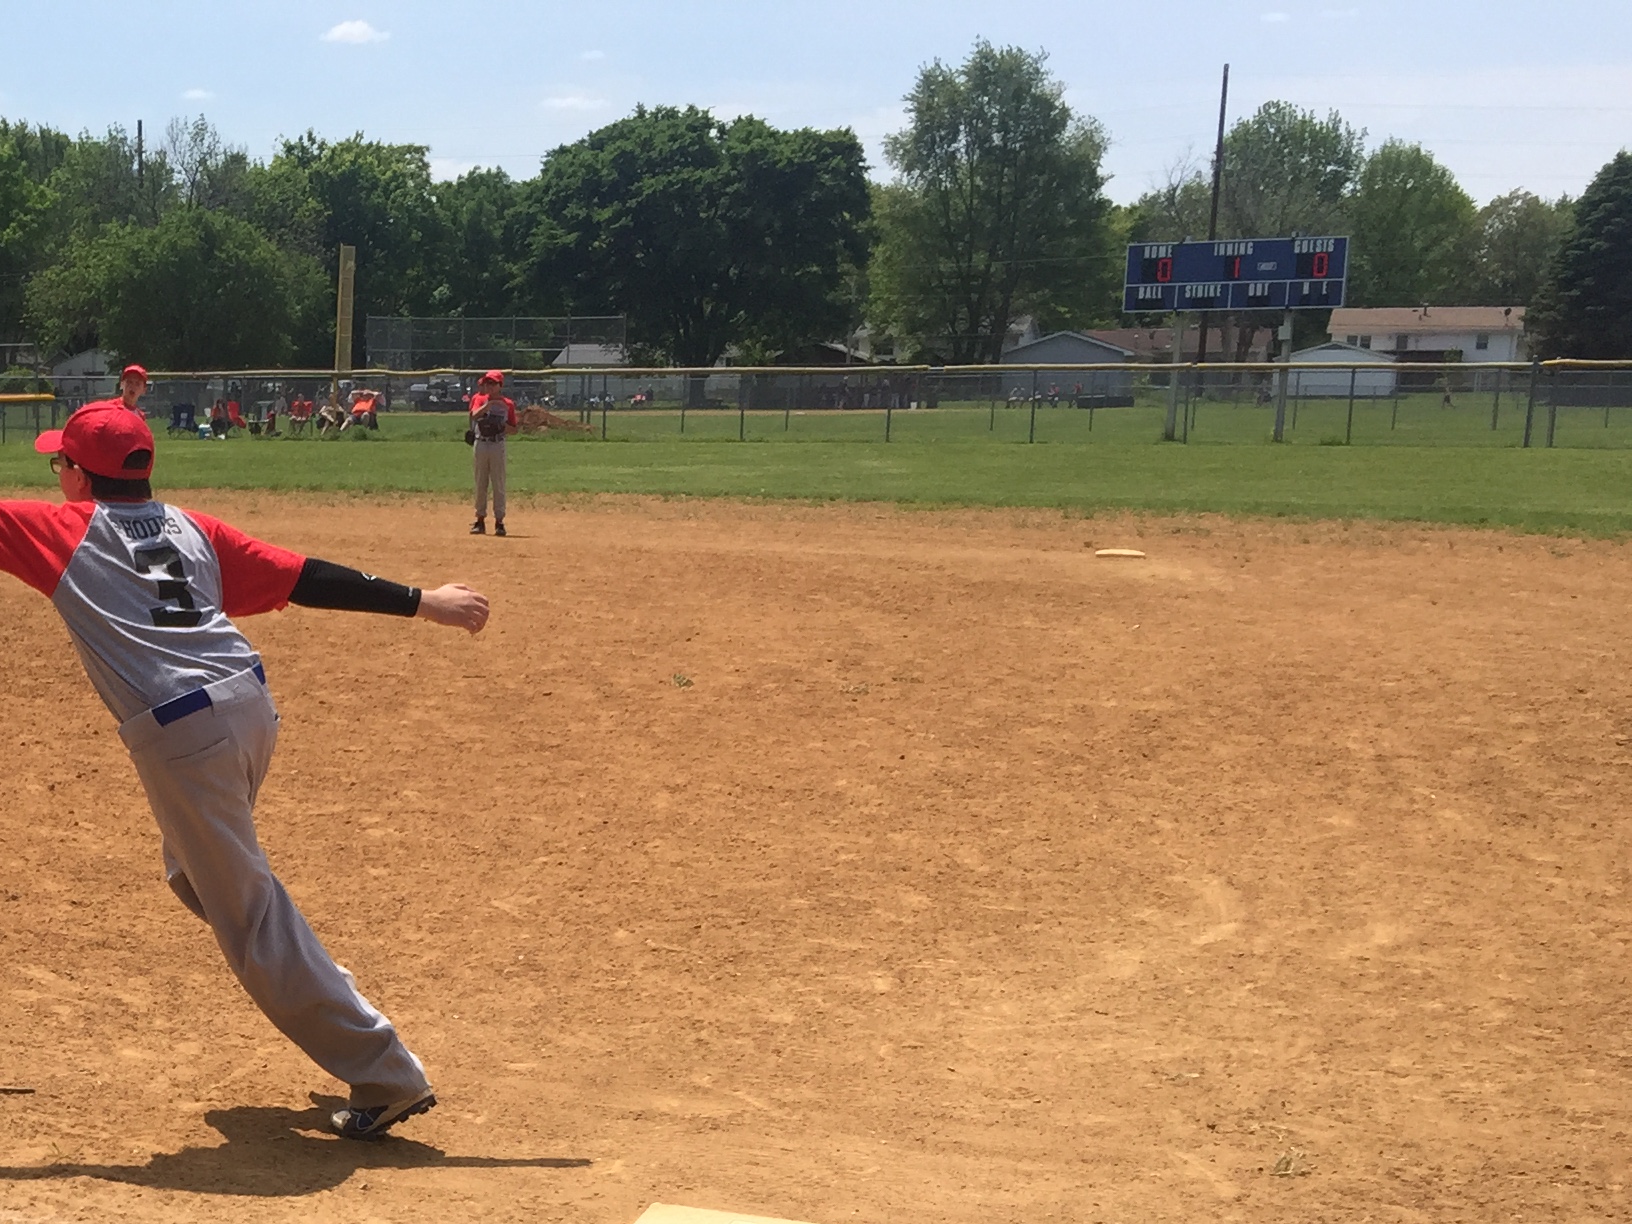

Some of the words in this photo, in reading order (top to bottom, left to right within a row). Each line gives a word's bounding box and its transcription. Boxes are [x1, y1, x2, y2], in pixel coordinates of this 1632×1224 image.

[1144, 245, 1173, 259] HOME
[1214, 241, 1254, 256] INNING
[1294, 239, 1335, 253] GUESTS
[1156, 257, 1172, 282] 0
[1234, 256, 1241, 279] 1
[1312, 252, 1329, 279] 0
[1138, 286, 1163, 299] BALL
[1185, 284, 1222, 298] STRIKE
[1248, 282, 1270, 296] OUT
